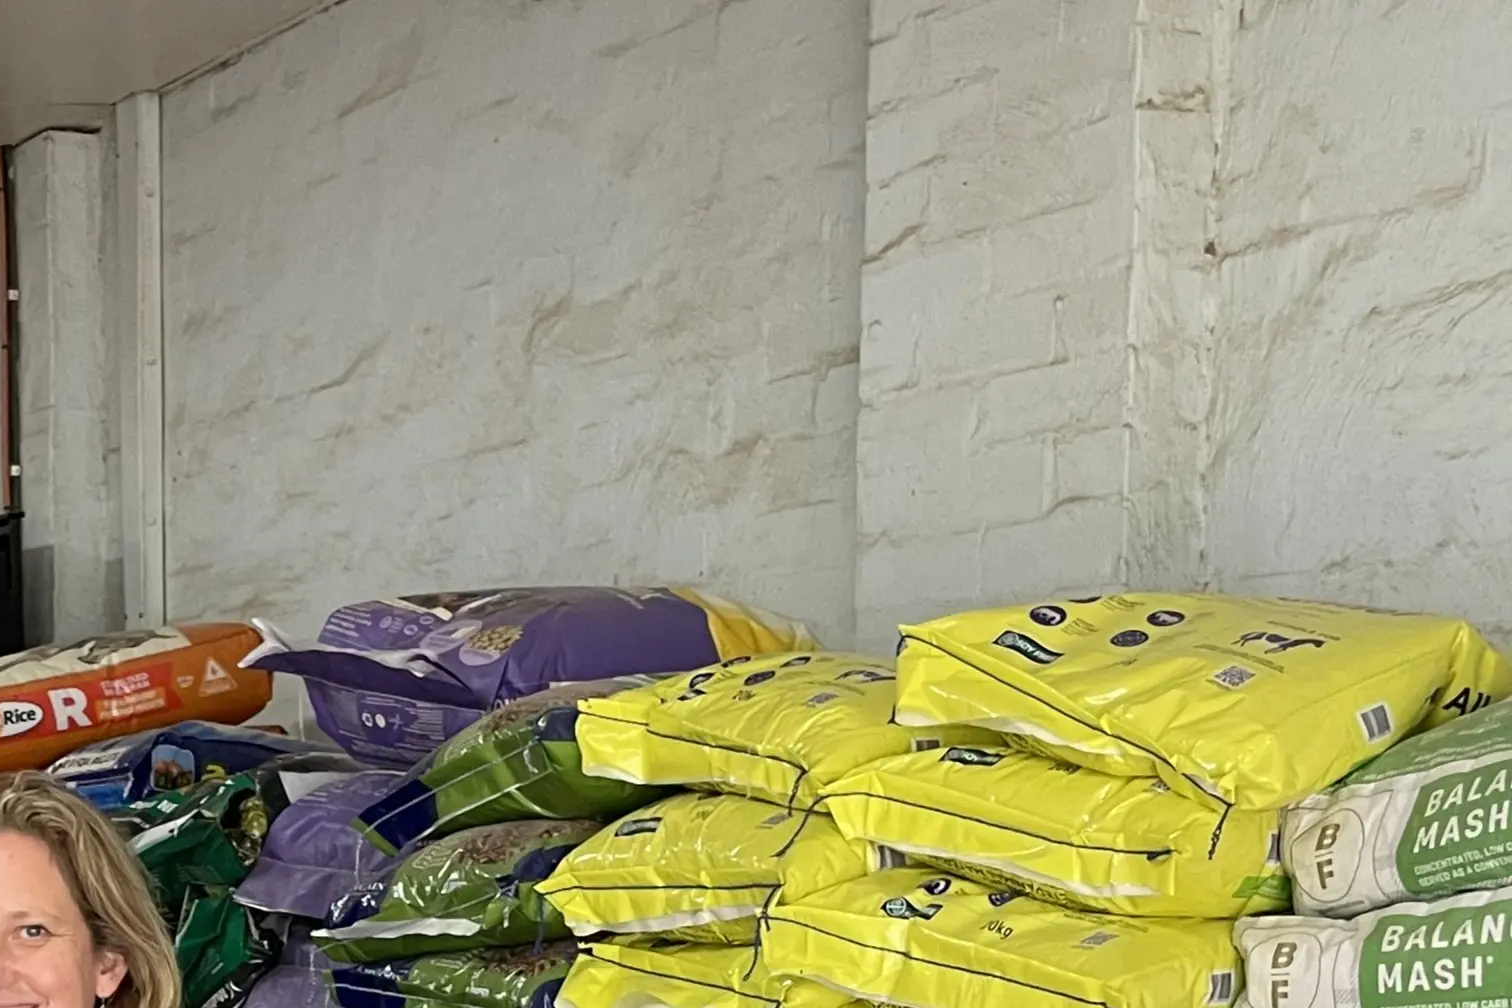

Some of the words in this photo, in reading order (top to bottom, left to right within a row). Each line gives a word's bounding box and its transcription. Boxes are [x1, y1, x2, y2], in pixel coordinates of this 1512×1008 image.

[47, 686, 94, 733] R
[1424, 768, 1512, 818] BALA
[1315, 823, 1340, 852] B
[1413, 799, 1510, 854] MASH
[1316, 857, 1334, 890] F
[1381, 912, 1512, 953] BALAN
[1272, 941, 1297, 970] B
[1377, 955, 1484, 995] MASH
[1272, 979, 1289, 1008] F
